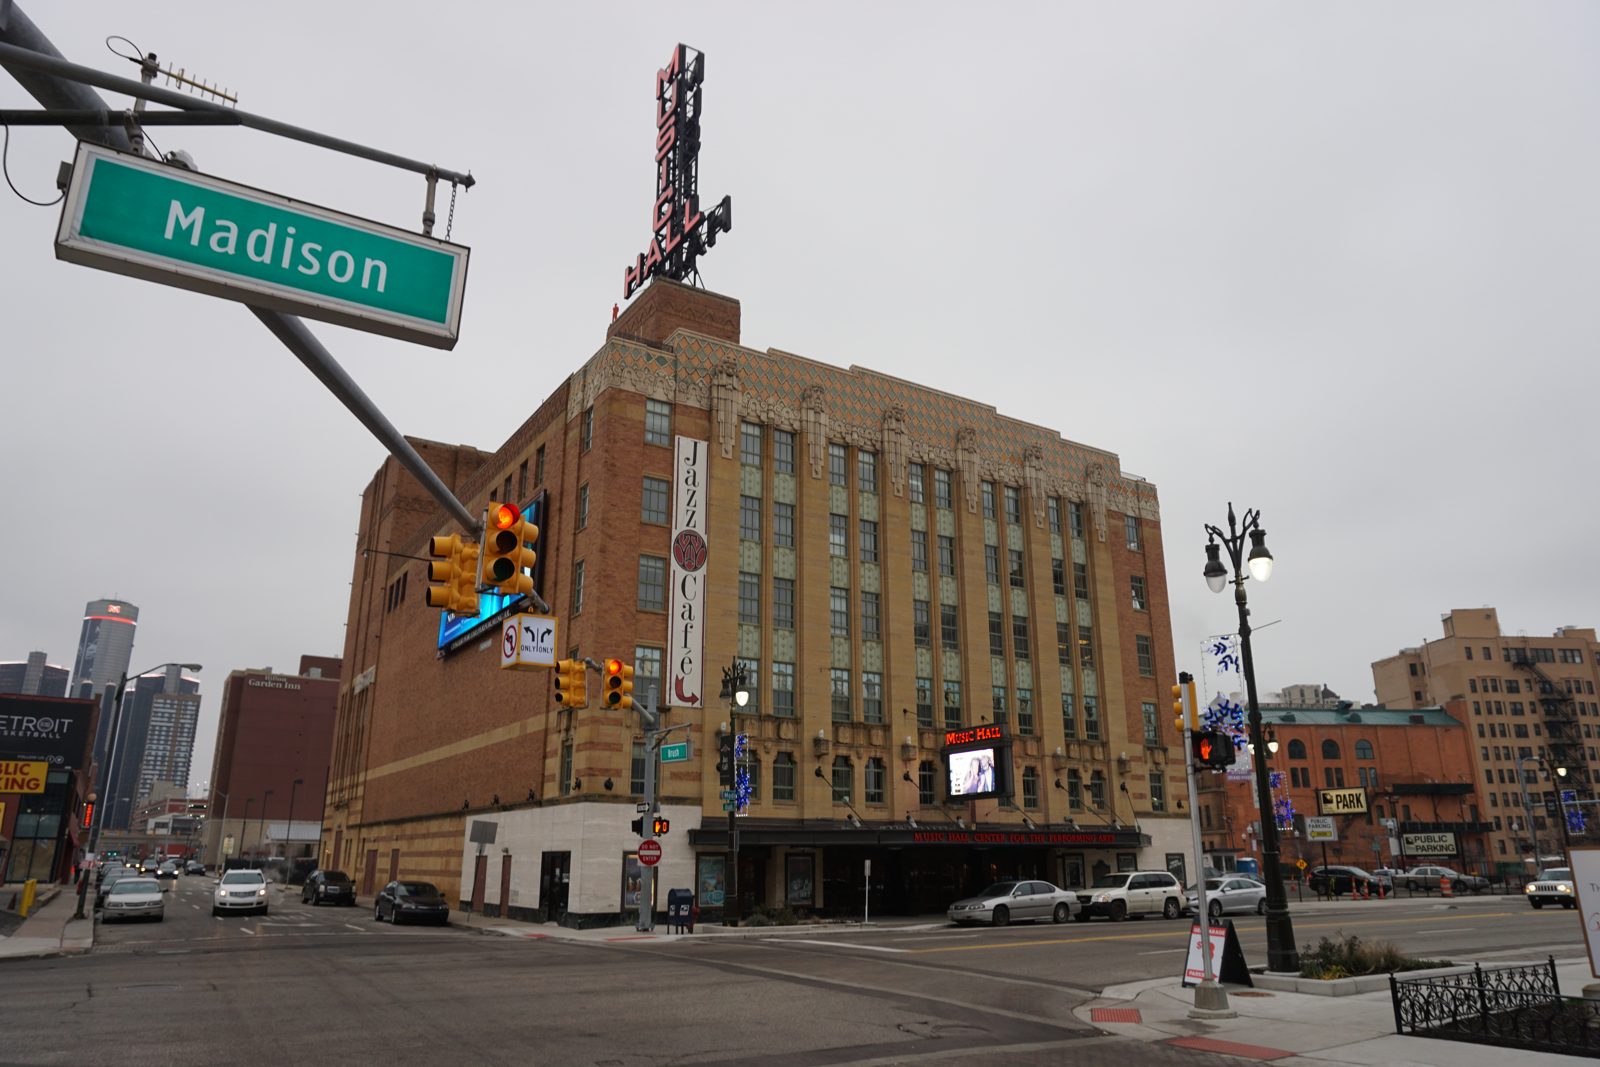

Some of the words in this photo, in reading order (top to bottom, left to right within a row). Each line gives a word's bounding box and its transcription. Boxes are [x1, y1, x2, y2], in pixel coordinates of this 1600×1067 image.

[653, 44, 681, 233] MUSIC
[164, 199, 388, 293] Madison
[624, 198, 701, 299] HALL
[684, 441, 699, 528] Jazz
[680, 574, 697, 676] Café
[521, 644, 536, 653] ONLY
[248, 679, 282, 688] Garden
[284, 682, 300, 690] Inn
[946, 731, 974, 745] MUSIC
[976, 727, 1001, 740] HALL
[667, 748, 680, 759] Brush
[1335, 793, 1364, 810] PARK
[1413, 834, 1448, 844] PUBLIC
[1415, 844, 1455, 853] PARKING
